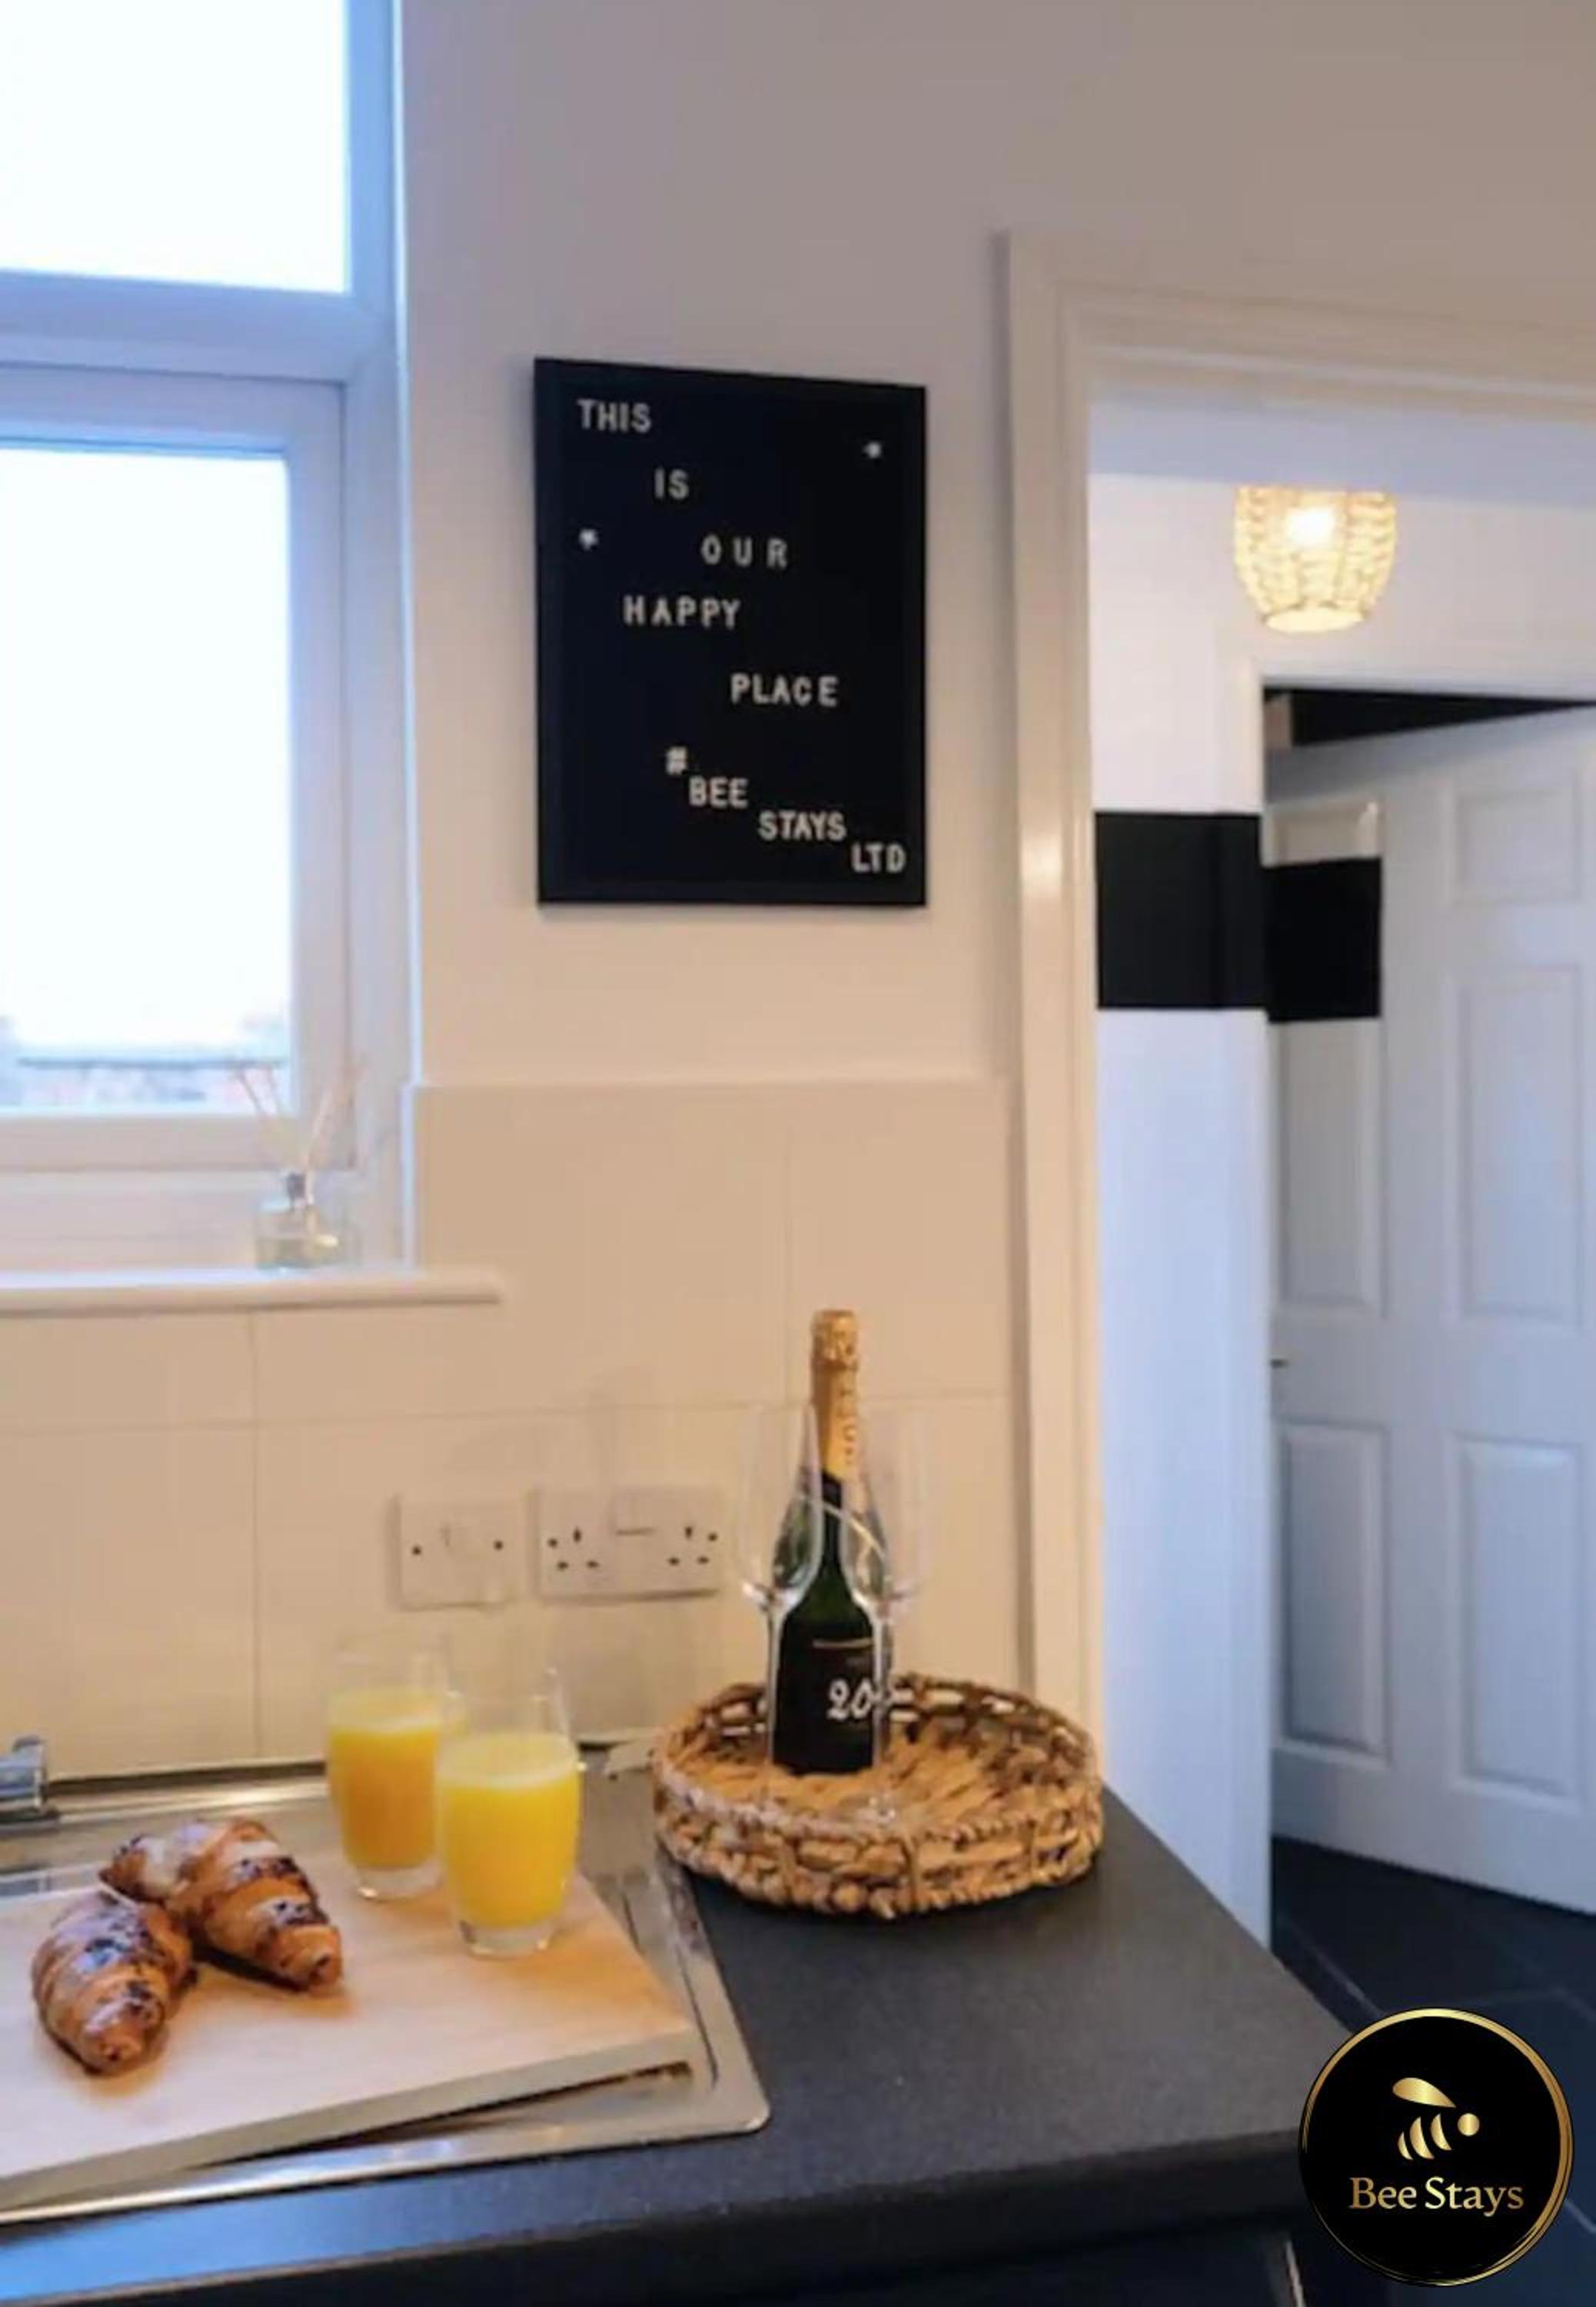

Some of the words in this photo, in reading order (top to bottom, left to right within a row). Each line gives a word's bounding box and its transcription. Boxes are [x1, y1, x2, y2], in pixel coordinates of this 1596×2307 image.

[578, 398, 652, 433] THIS
[655, 468, 689, 499] IS
[700, 534, 787, 568] OUR
[623, 594, 740, 628] HAPPY
[730, 672, 839, 707] PLACE
[759, 811, 846, 841] STAYS
[851, 843, 906, 873] LTD
